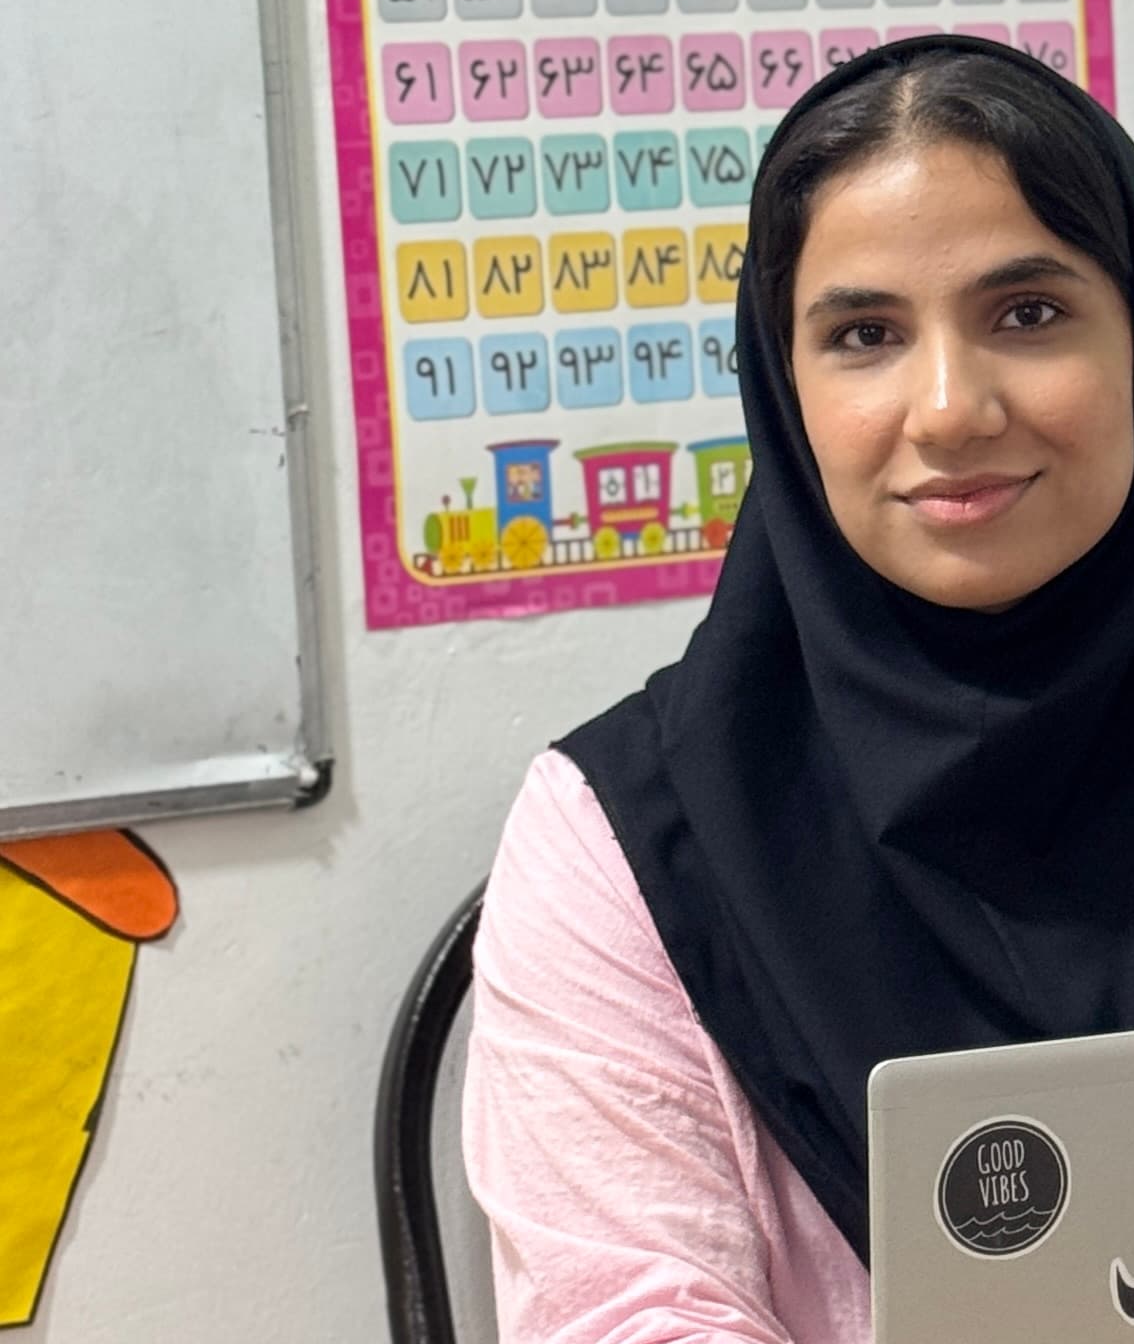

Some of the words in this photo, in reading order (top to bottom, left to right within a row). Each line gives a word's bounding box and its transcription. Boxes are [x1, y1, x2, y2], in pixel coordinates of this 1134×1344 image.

[394, 61, 437, 104] ۶۱
[469, 58, 519, 101] ۶۲
[537, 56, 595, 98] ۶۳
[614, 52, 664, 95] ۶۴
[685, 51, 739, 93] ۶۵
[758, 47, 804, 89] ۶۶
[397, 157, 447, 199] ۷۱
[470, 153, 526, 195] ۷۲
[543, 150, 605, 192] ۷۳
[617, 145, 674, 188] ۷۴
[689, 144, 747, 185] ۷۵
[407, 258, 454, 301] ۸۱
[481, 254, 533, 296] ۸۲
[552, 249, 610, 291] ۸۳
[627, 244, 681, 287] ۸۴
[415, 355, 456, 398] ۹۱
[490, 349, 538, 391] ۹۲
[557, 344, 616, 386] ۹۳
[632, 338, 683, 381] ۹۴
[977, 1138, 1025, 1175] GOOD
[978, 1169, 1030, 1209] VIBES
